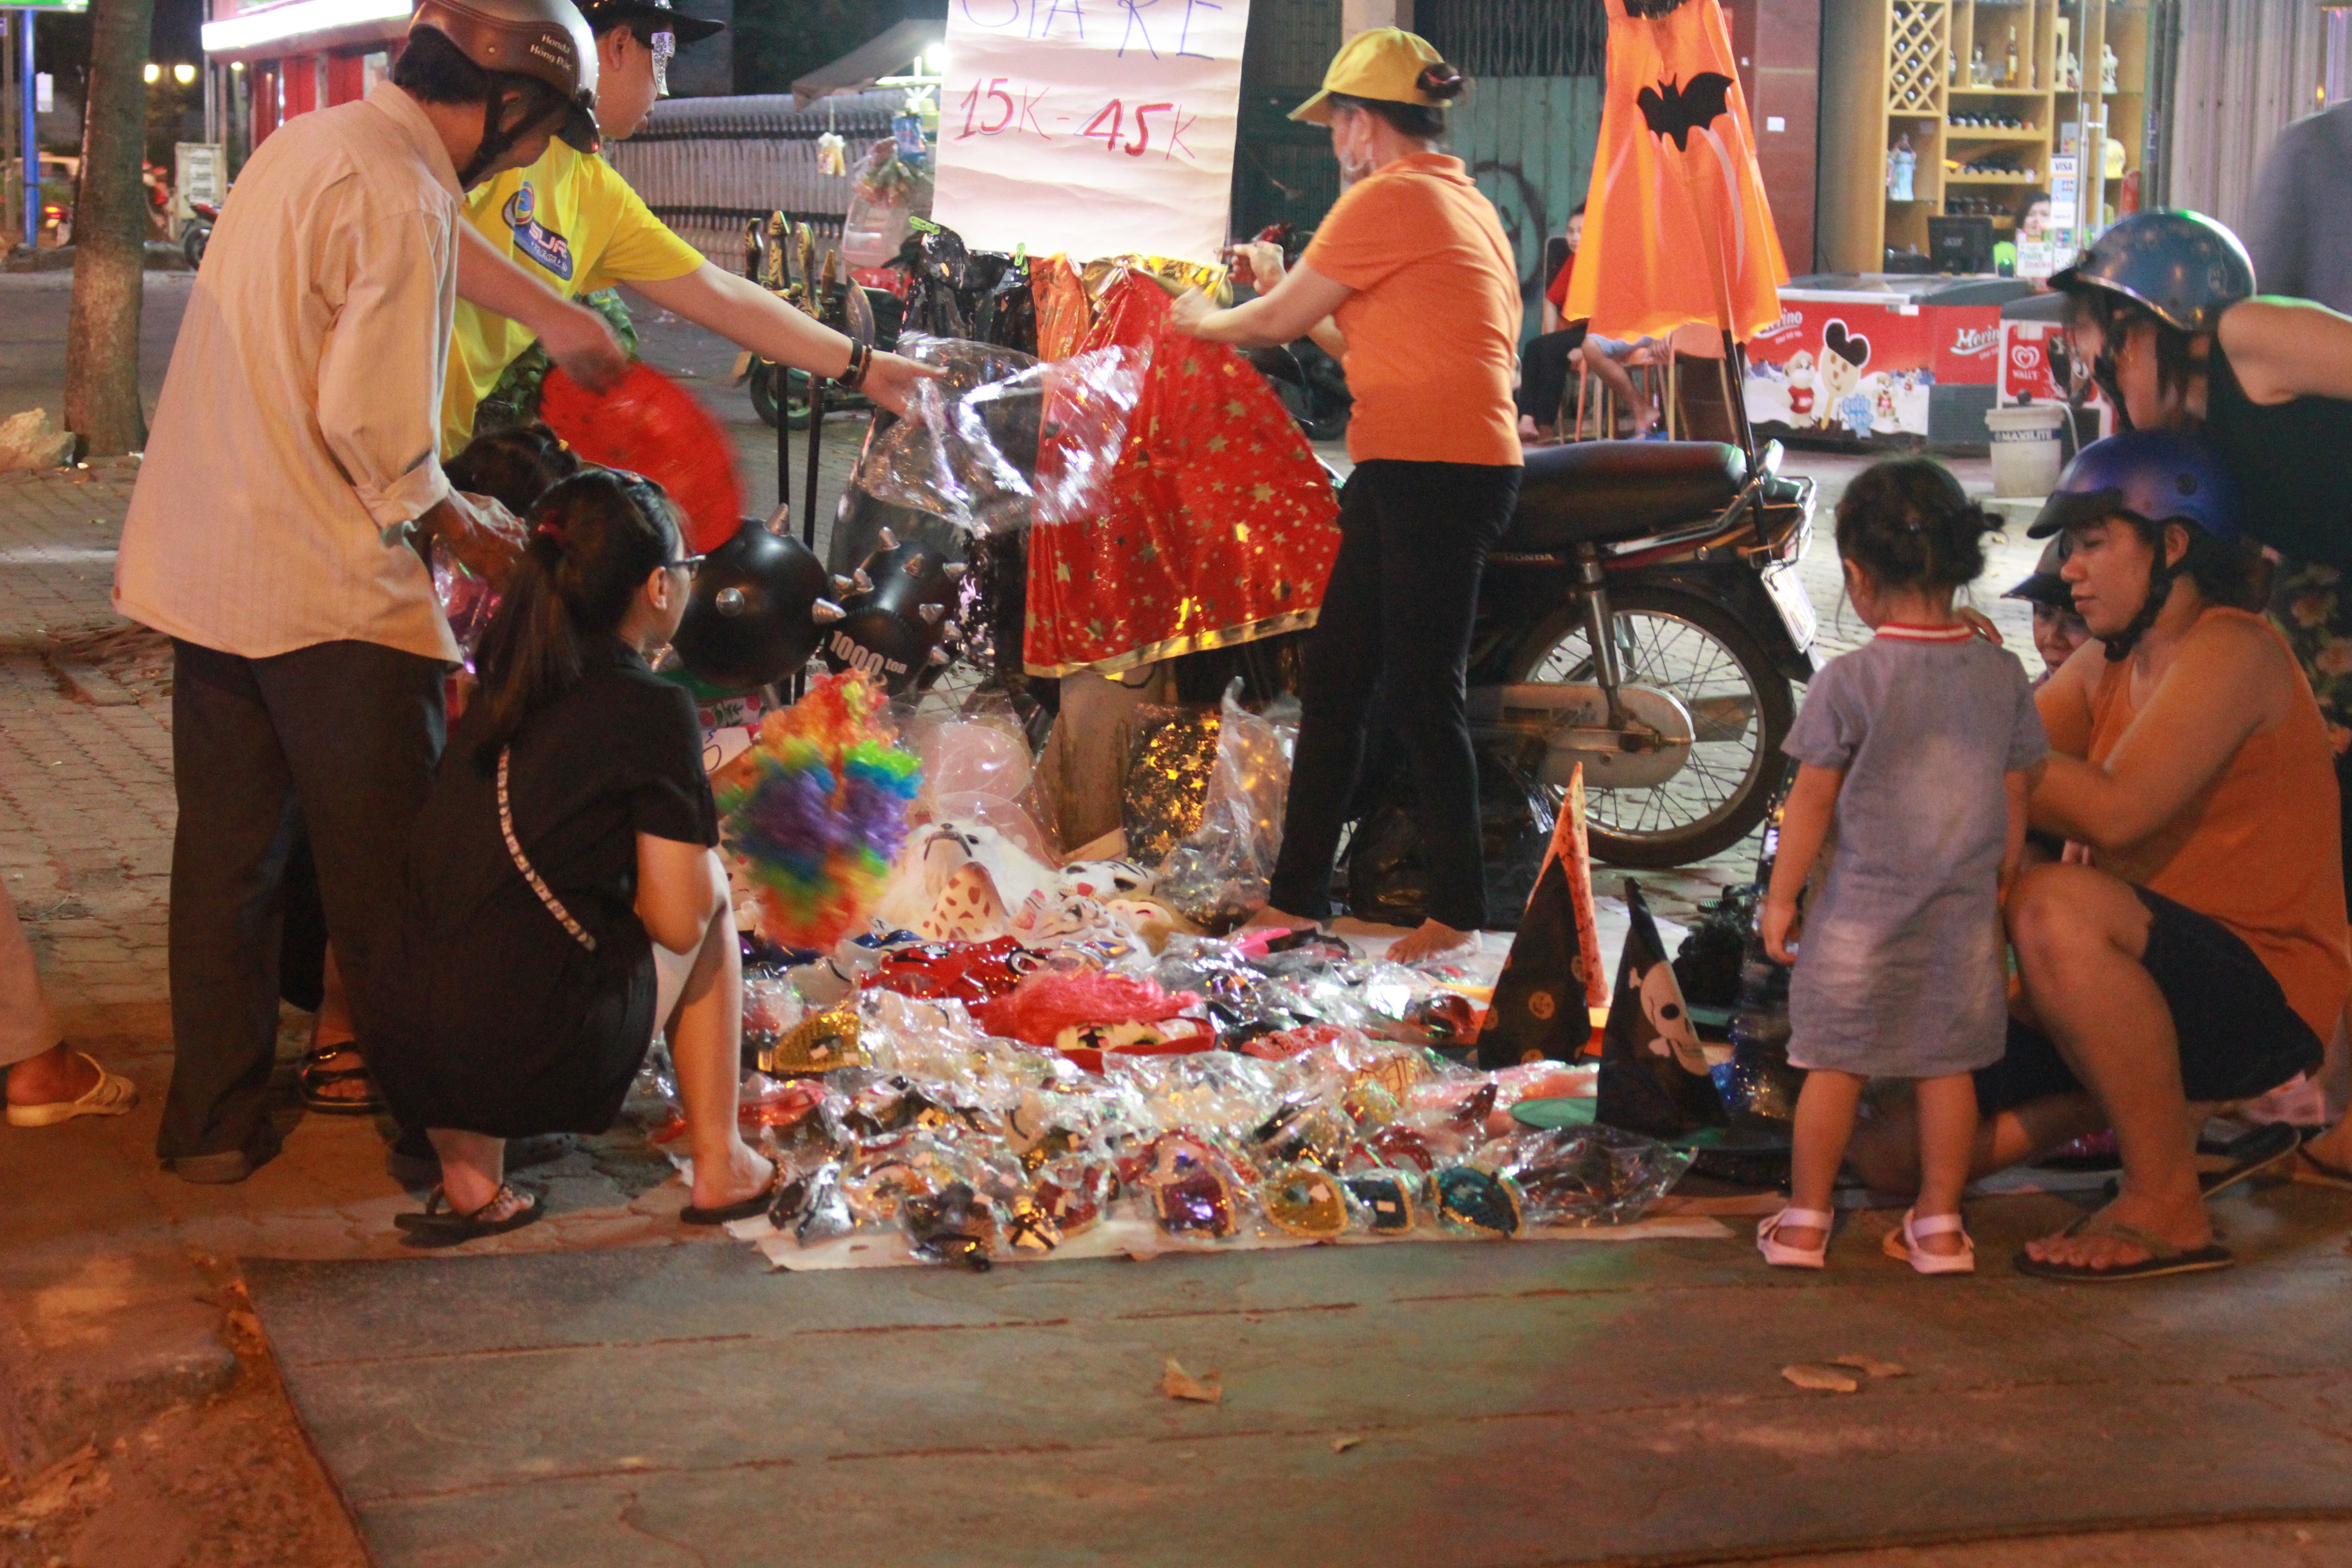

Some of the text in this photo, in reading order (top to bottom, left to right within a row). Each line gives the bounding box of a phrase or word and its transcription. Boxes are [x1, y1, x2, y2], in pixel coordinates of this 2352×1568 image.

[542, 34, 570, 54] Honda
[955, 78, 1051, 141] 15K
[1073, 98, 1197, 161] 45K
[2055, 162, 2073, 171] VISA
[1955, 324, 2000, 349] Merin
[830, 631, 907, 676] 1000 ton
